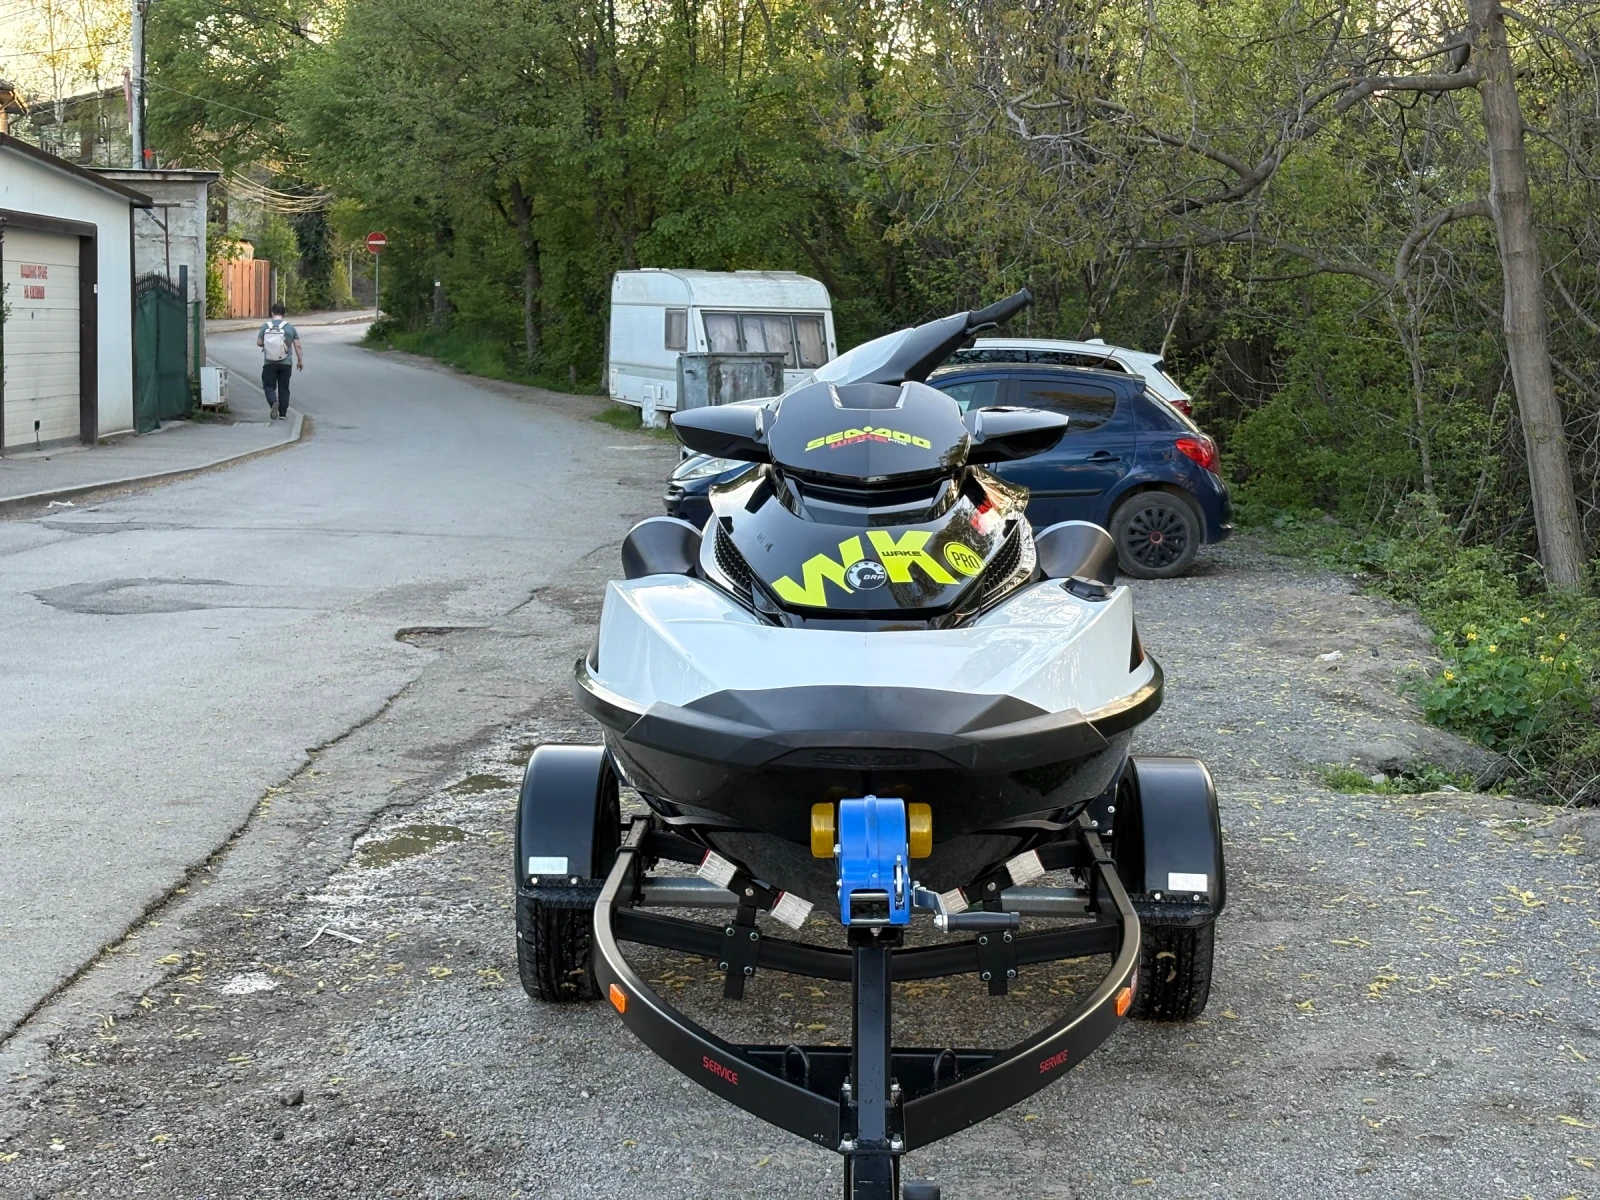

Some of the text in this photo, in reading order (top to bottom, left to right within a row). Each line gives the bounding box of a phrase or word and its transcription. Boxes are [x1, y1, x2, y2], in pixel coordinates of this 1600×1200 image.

[829, 433, 888, 449] WAKE
[951, 551, 979, 570] PRO
[702, 1055, 738, 1085] SERVICE
[1039, 1049, 1069, 1074] SERVICE
